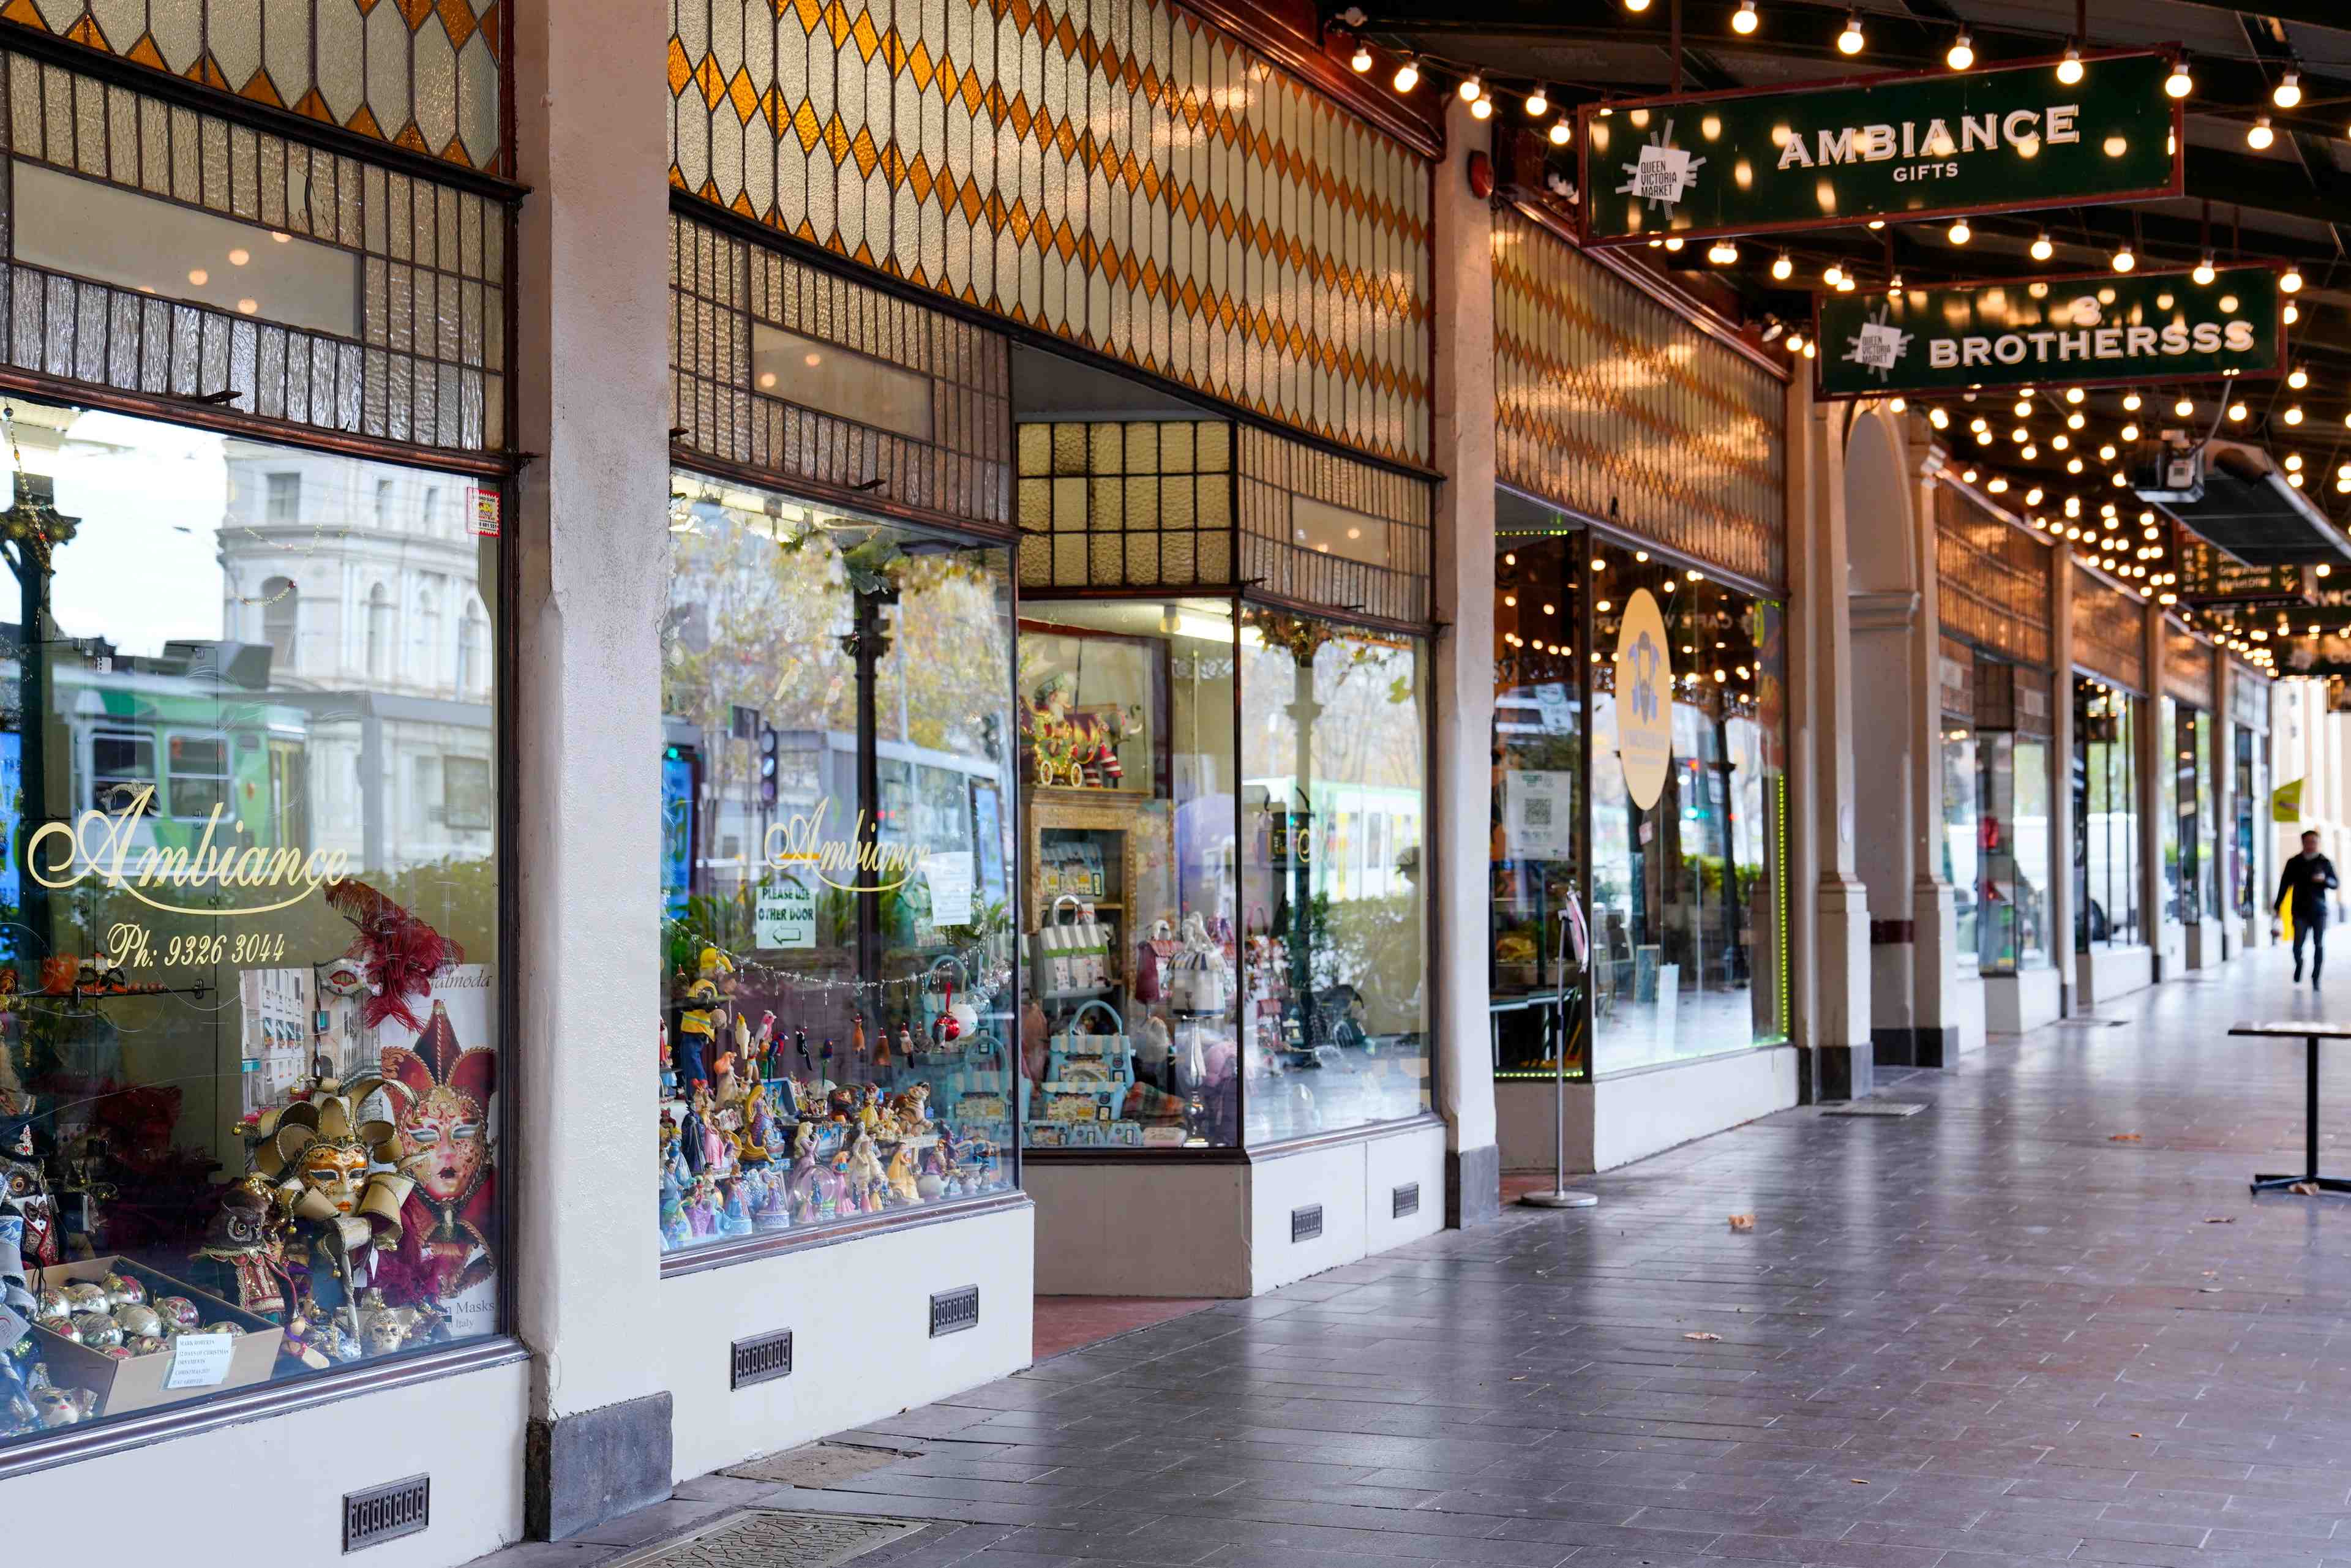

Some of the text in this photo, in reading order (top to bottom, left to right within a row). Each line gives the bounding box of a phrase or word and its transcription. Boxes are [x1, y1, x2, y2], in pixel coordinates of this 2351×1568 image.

[1777, 103, 2080, 170] AMBIANCE
[1641, 160, 1666, 174] QUEEN
[1892, 162, 1959, 183] GIFTS
[1641, 172, 1677, 186] VICTORIA
[1641, 184, 1673, 198] MARKET
[1862, 336, 1882, 346] QUEEN
[1928, 320, 2255, 369] BROTHERSSS
[28, 784, 350, 915] Ambiance
[764, 796, 931, 892] Ambiance
[762, 887, 810, 900] PLEASE USE
[759, 908, 814, 921] OTHER DOOR
[107, 923, 285, 969] Ph: 9326 3044
[456, 1300, 495, 1314] Masks
[456, 1318, 474, 1329] Italy
